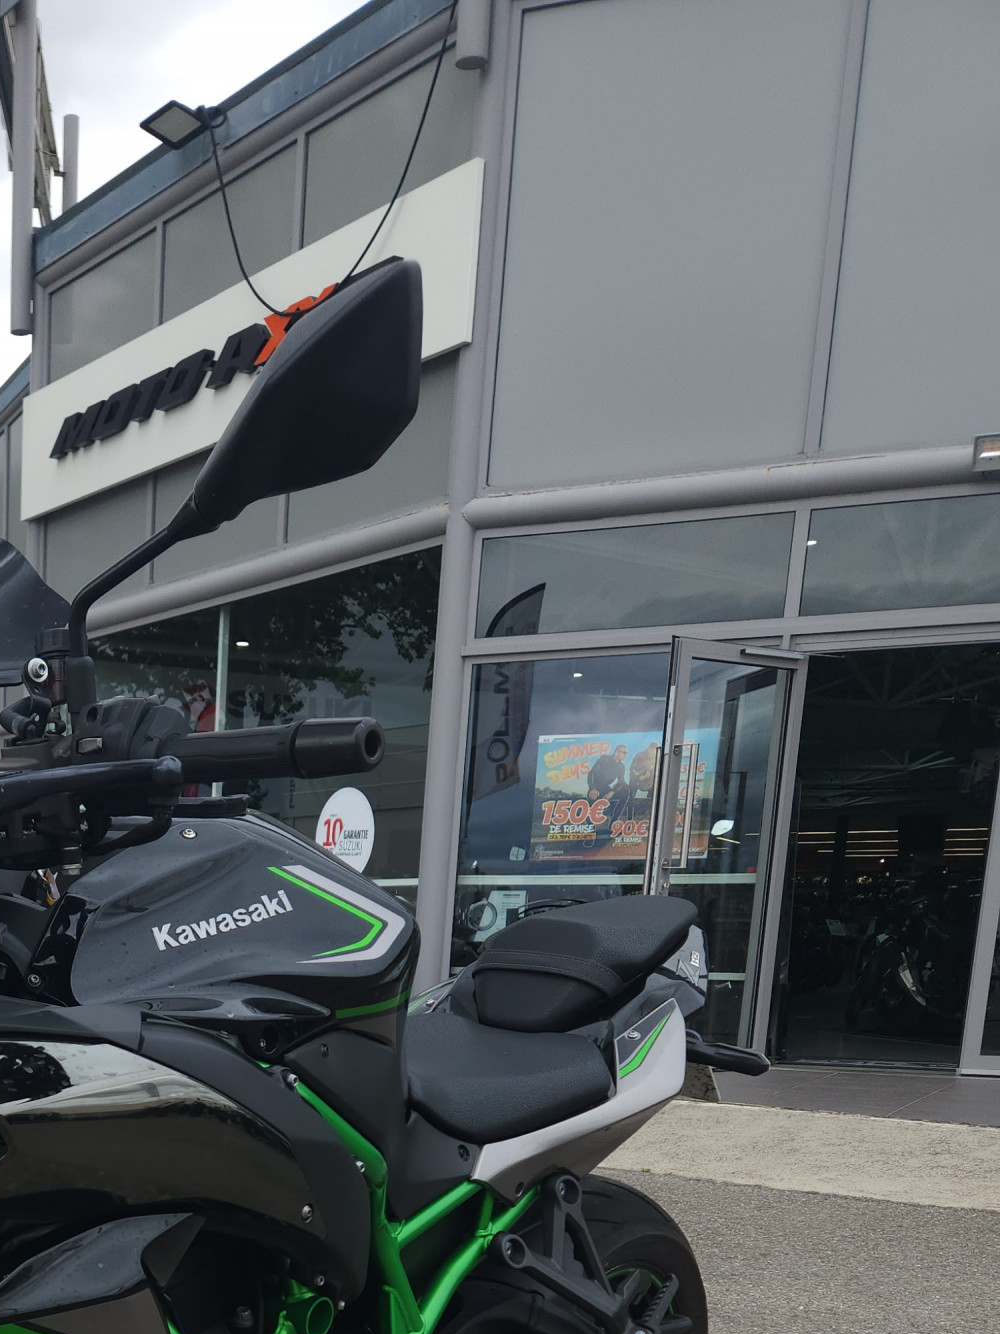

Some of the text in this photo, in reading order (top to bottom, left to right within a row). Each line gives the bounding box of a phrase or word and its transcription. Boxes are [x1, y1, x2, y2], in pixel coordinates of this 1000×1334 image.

[543, 740, 611, 768] SUMMER
[542, 798, 611, 825] 150€
[323, 817, 344, 847] 10
[343, 829, 369, 840] GARANTIE
[549, 824, 595, 833] DE REMISE
[610, 819, 650, 838] 90€
[338, 840, 363, 851] SUZUKI
[150, 889, 294, 952] Kawasaki
